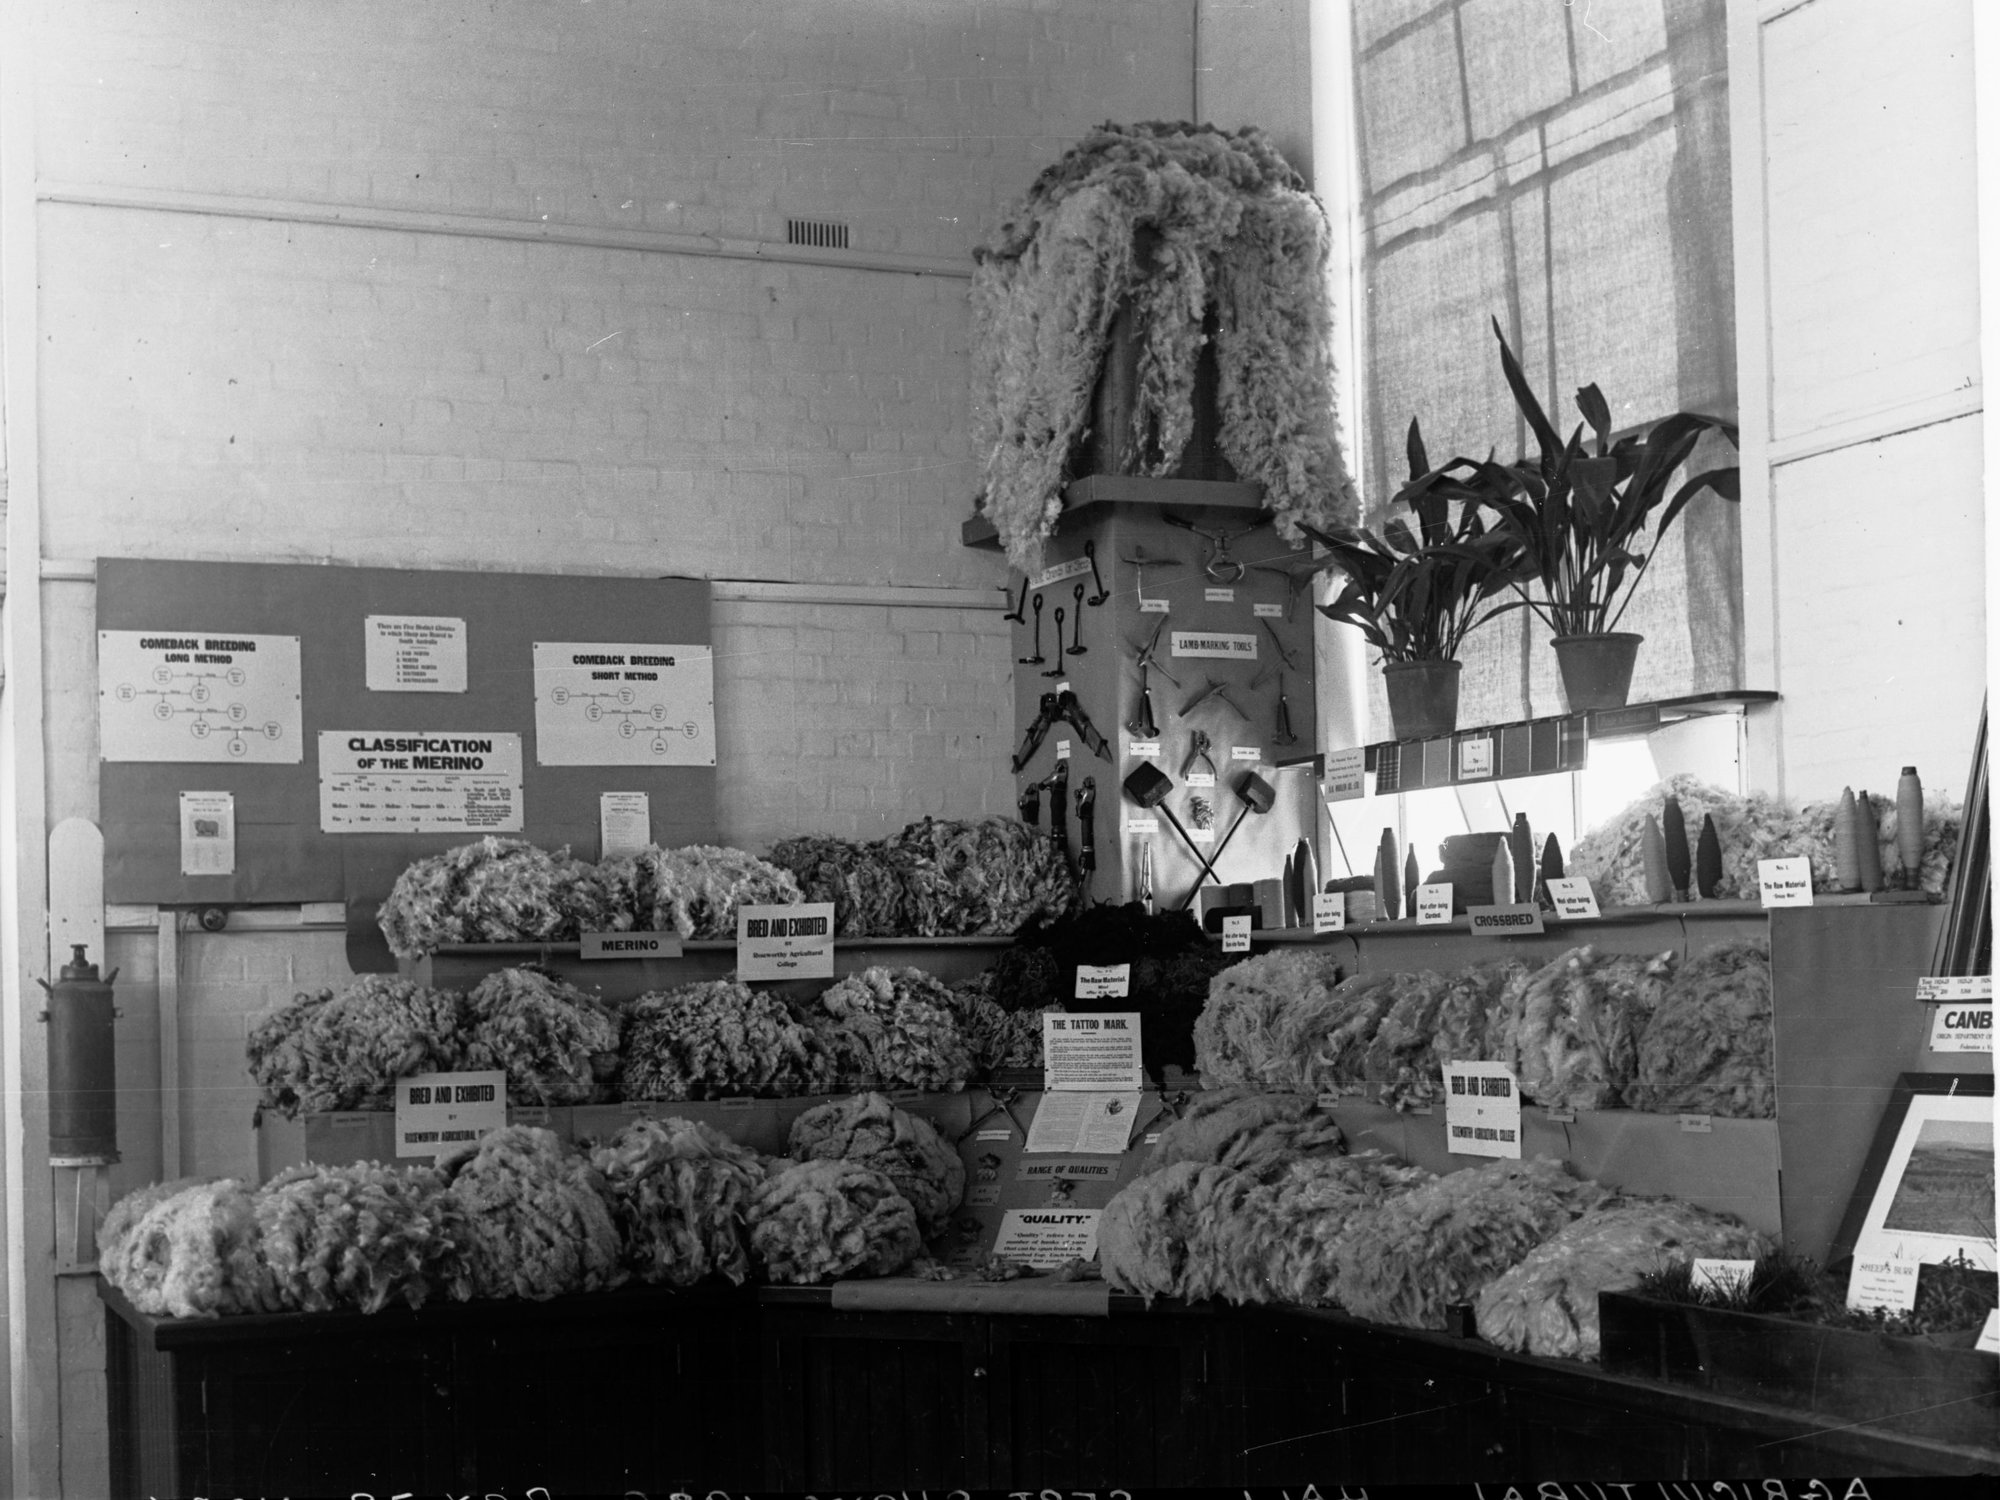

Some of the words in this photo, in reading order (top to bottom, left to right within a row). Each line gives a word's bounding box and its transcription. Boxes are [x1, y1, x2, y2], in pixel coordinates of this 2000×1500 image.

[140, 638, 199, 650] COMEBACK
[204, 639, 256, 652] BREEDING
[1233, 641, 1252, 652] TOOLS
[165, 653, 190, 663] LONG
[194, 654, 233, 664] METHOD
[572, 655, 625, 665] COMEBACK
[630, 656, 676, 666] BREEDING
[592, 672, 620, 681] SHORT
[624, 672, 658, 681] METHOD
[348, 738, 492, 753] CLASSIFICATION
[357, 758, 377, 769] OF
[380, 758, 408, 769] THE
[412, 756, 484, 770] MERINO
[1773, 881, 1783, 889] Raw
[1785, 880, 1806, 889] Material
[1577, 896, 1591, 904] being
[1437, 902, 1448, 910] being
[1474, 913, 1534, 927] CROSSBRED
[747, 919, 769, 938] BRED
[770, 918, 788, 937] AND
[789, 916, 827, 937] EXHIBITED
[601, 940, 659, 951] MERINO
[789, 949, 824, 958] Agricultural
[1052, 1019, 1066, 1030] THE
[1070, 1019, 1100, 1030] TATTOO
[1104, 1019, 1129, 1030] MARK.
[1451, 1075, 1466, 1095] BRED
[1467, 1076, 1479, 1096] AND
[1481, 1076, 1511, 1098] EXHIBITED
[409, 1087, 431, 1105] BRED
[434, 1086, 452, 1104] AND
[455, 1085, 495, 1103] EXHIBITED
[1027, 1166, 1053, 1175] RANGE
[1055, 1165, 1066, 1174] OF
[1068, 1165, 1109, 1175] QUALITIES
[1019, 1215, 1091, 1224] "QUALITY."
[1894, 1266, 1914, 1275] BURR
